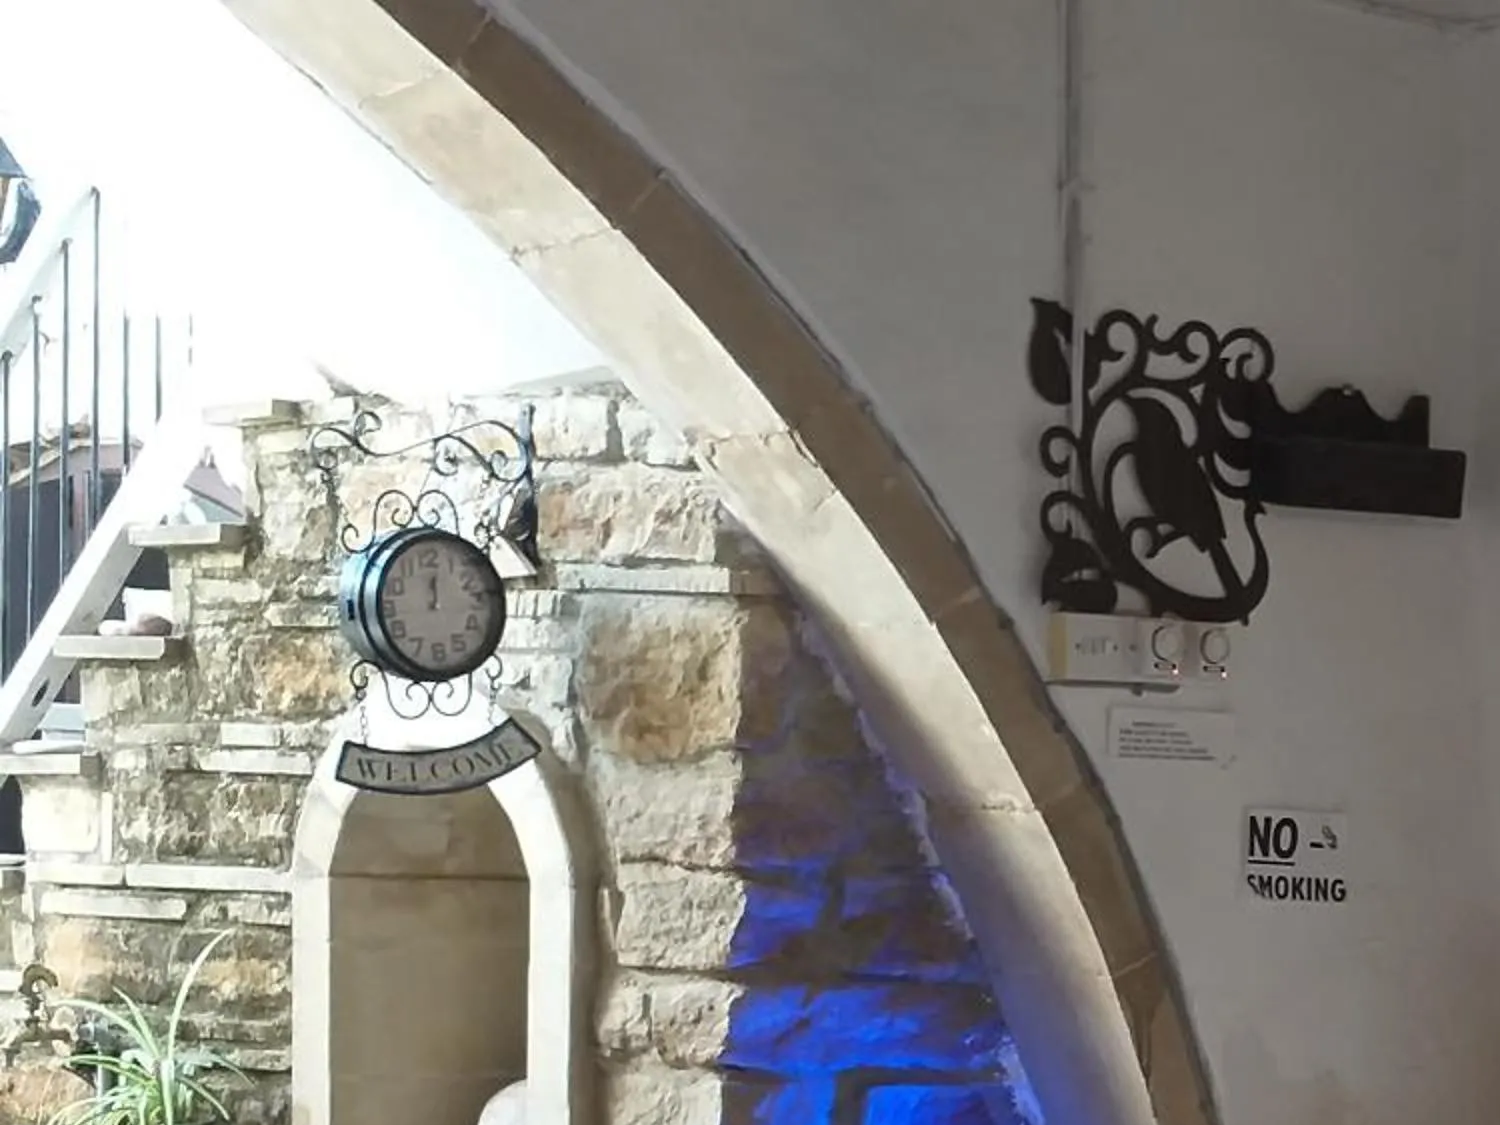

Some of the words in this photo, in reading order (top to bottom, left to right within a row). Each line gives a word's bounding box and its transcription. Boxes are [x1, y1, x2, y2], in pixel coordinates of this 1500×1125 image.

[417, 550, 439, 568] 12
[391, 619, 406, 639] 8
[465, 613, 478, 631] 4
[408, 636, 424, 657] 7
[430, 642, 446, 662] 6
[450, 633, 466, 652] 5
[357, 740, 521, 782] WELCOME
[1248, 815, 1299, 859] NO
[1247, 874, 1347, 902] SMOKING
